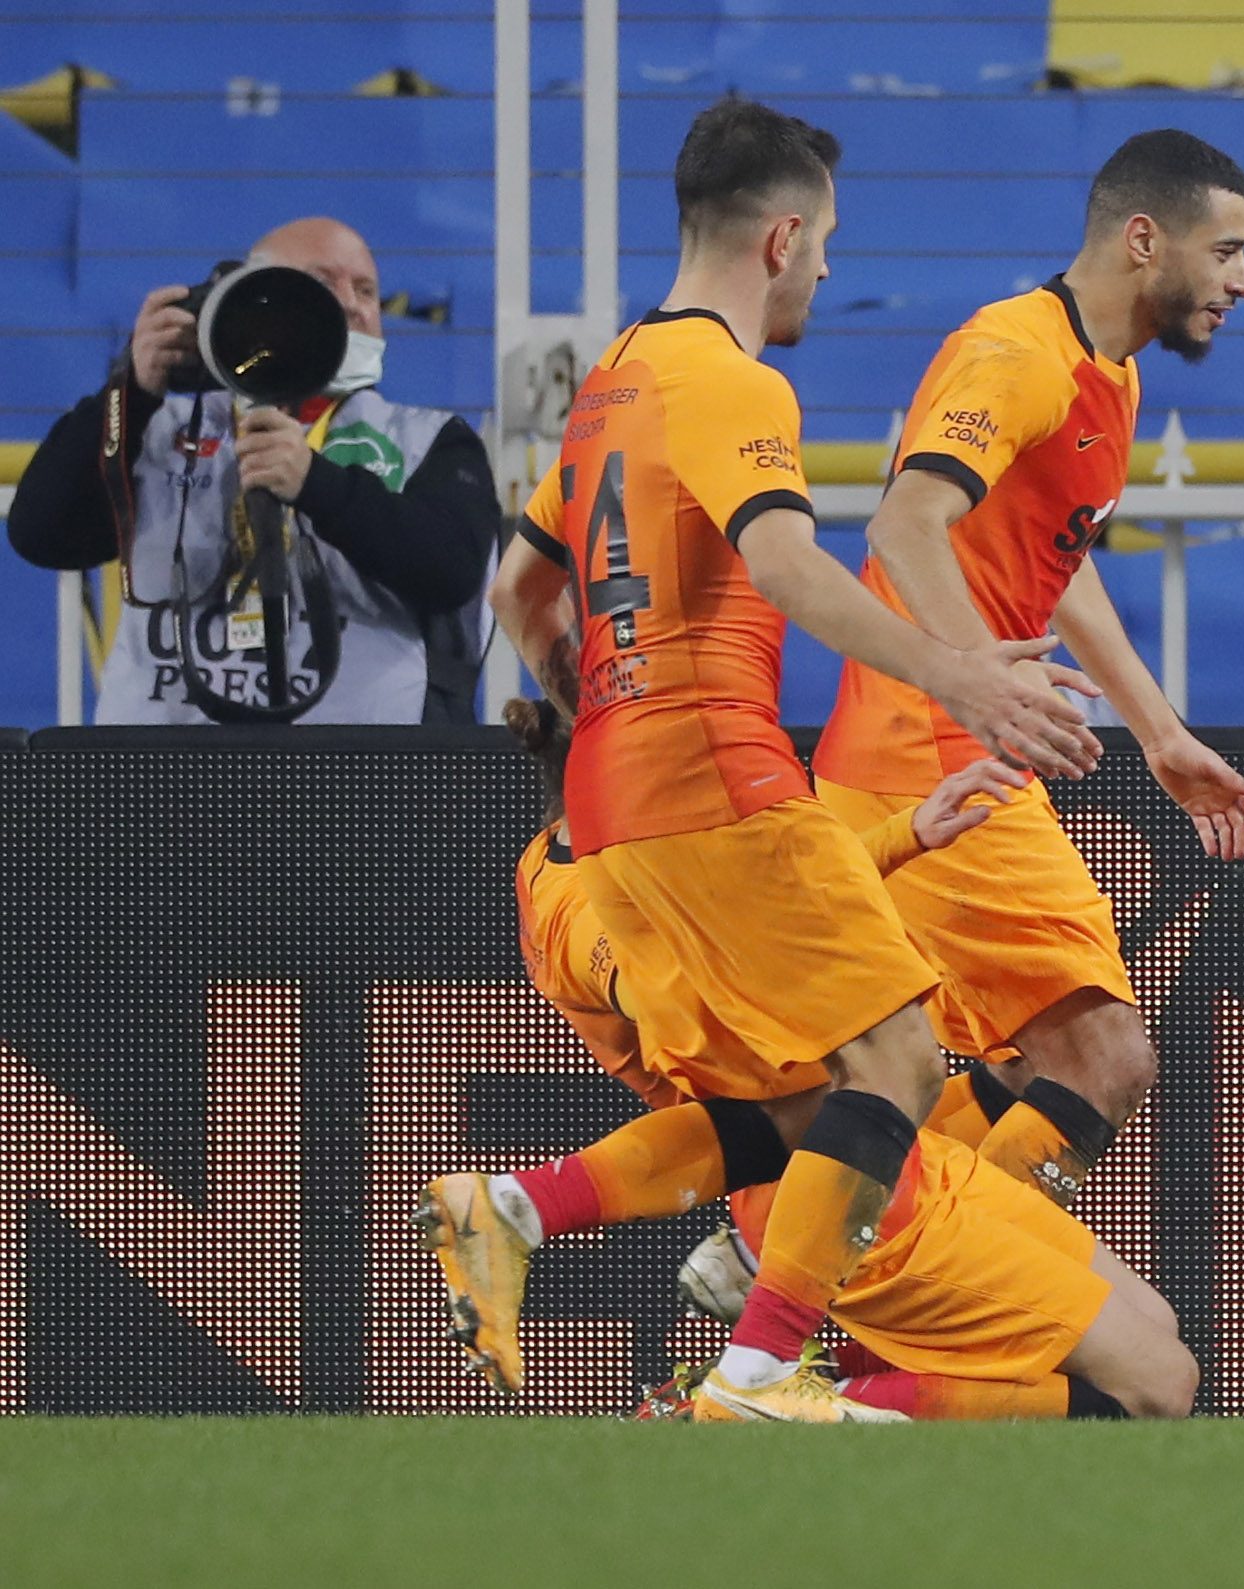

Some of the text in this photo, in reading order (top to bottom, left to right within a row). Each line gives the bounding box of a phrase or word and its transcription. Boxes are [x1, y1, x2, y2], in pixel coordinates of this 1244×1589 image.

[104, 388, 120, 458] Canon
[938, 426, 990, 454] .COM
[561, 451, 652, 651] 4
